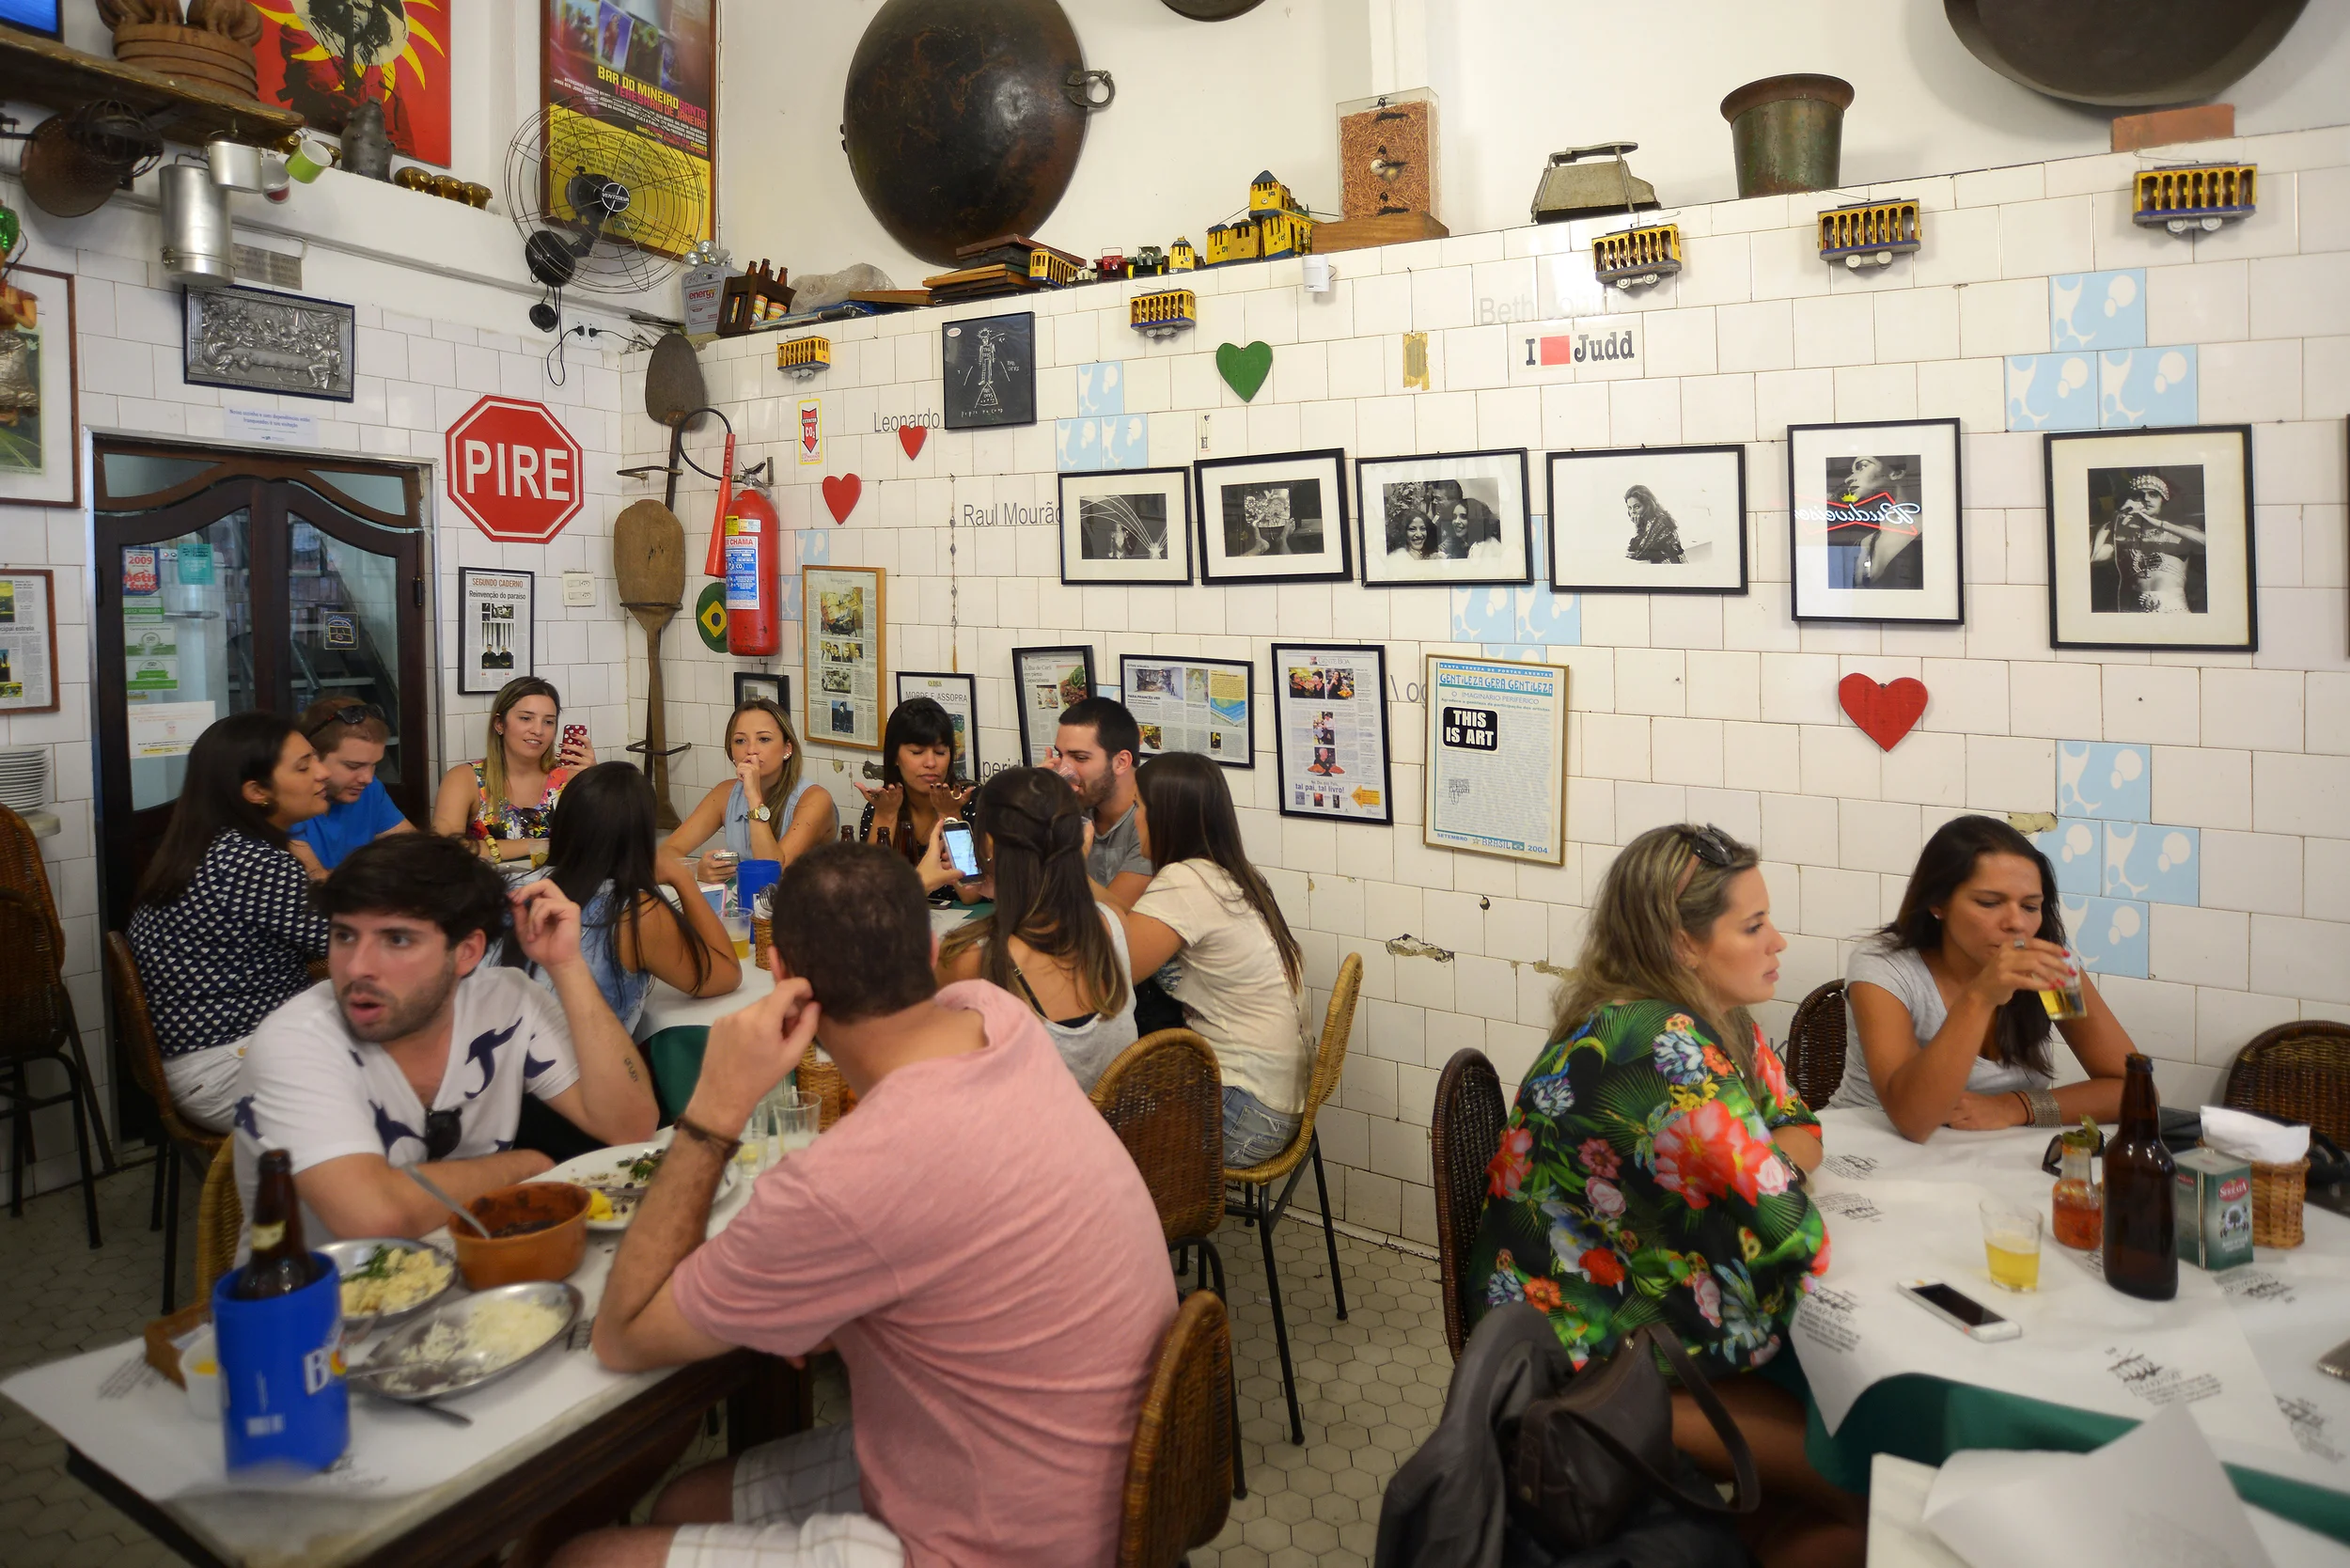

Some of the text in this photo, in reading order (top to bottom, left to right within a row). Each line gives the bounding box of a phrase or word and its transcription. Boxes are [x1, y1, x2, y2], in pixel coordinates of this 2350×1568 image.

[598, 65, 707, 120] BAR DO MINEIRO SANTA
[614, 84, 707, 130] TERESA RIO DE JANEIRO
[689, 286, 715, 299] energy
[1479, 294, 1536, 325] Beth
[1525, 331, 1635, 366] I Judd
[873, 408, 940, 432] Leonardo
[464, 439, 570, 501] PIRE
[964, 503, 997, 526] Raul
[129, 556, 152, 565] 2009
[472, 578, 524, 588] SEGUNDO CADERNO
[469, 590, 498, 600] Reinvenção
[1485, 677, 1505, 689] GERA
[936, 693, 968, 702] ASSOPRA
[1452, 710, 1487, 728] THIS
[1446, 727, 1494, 746] IS ART
[1437, 833, 1548, 854] SETEMBRO BRASIL 2004
